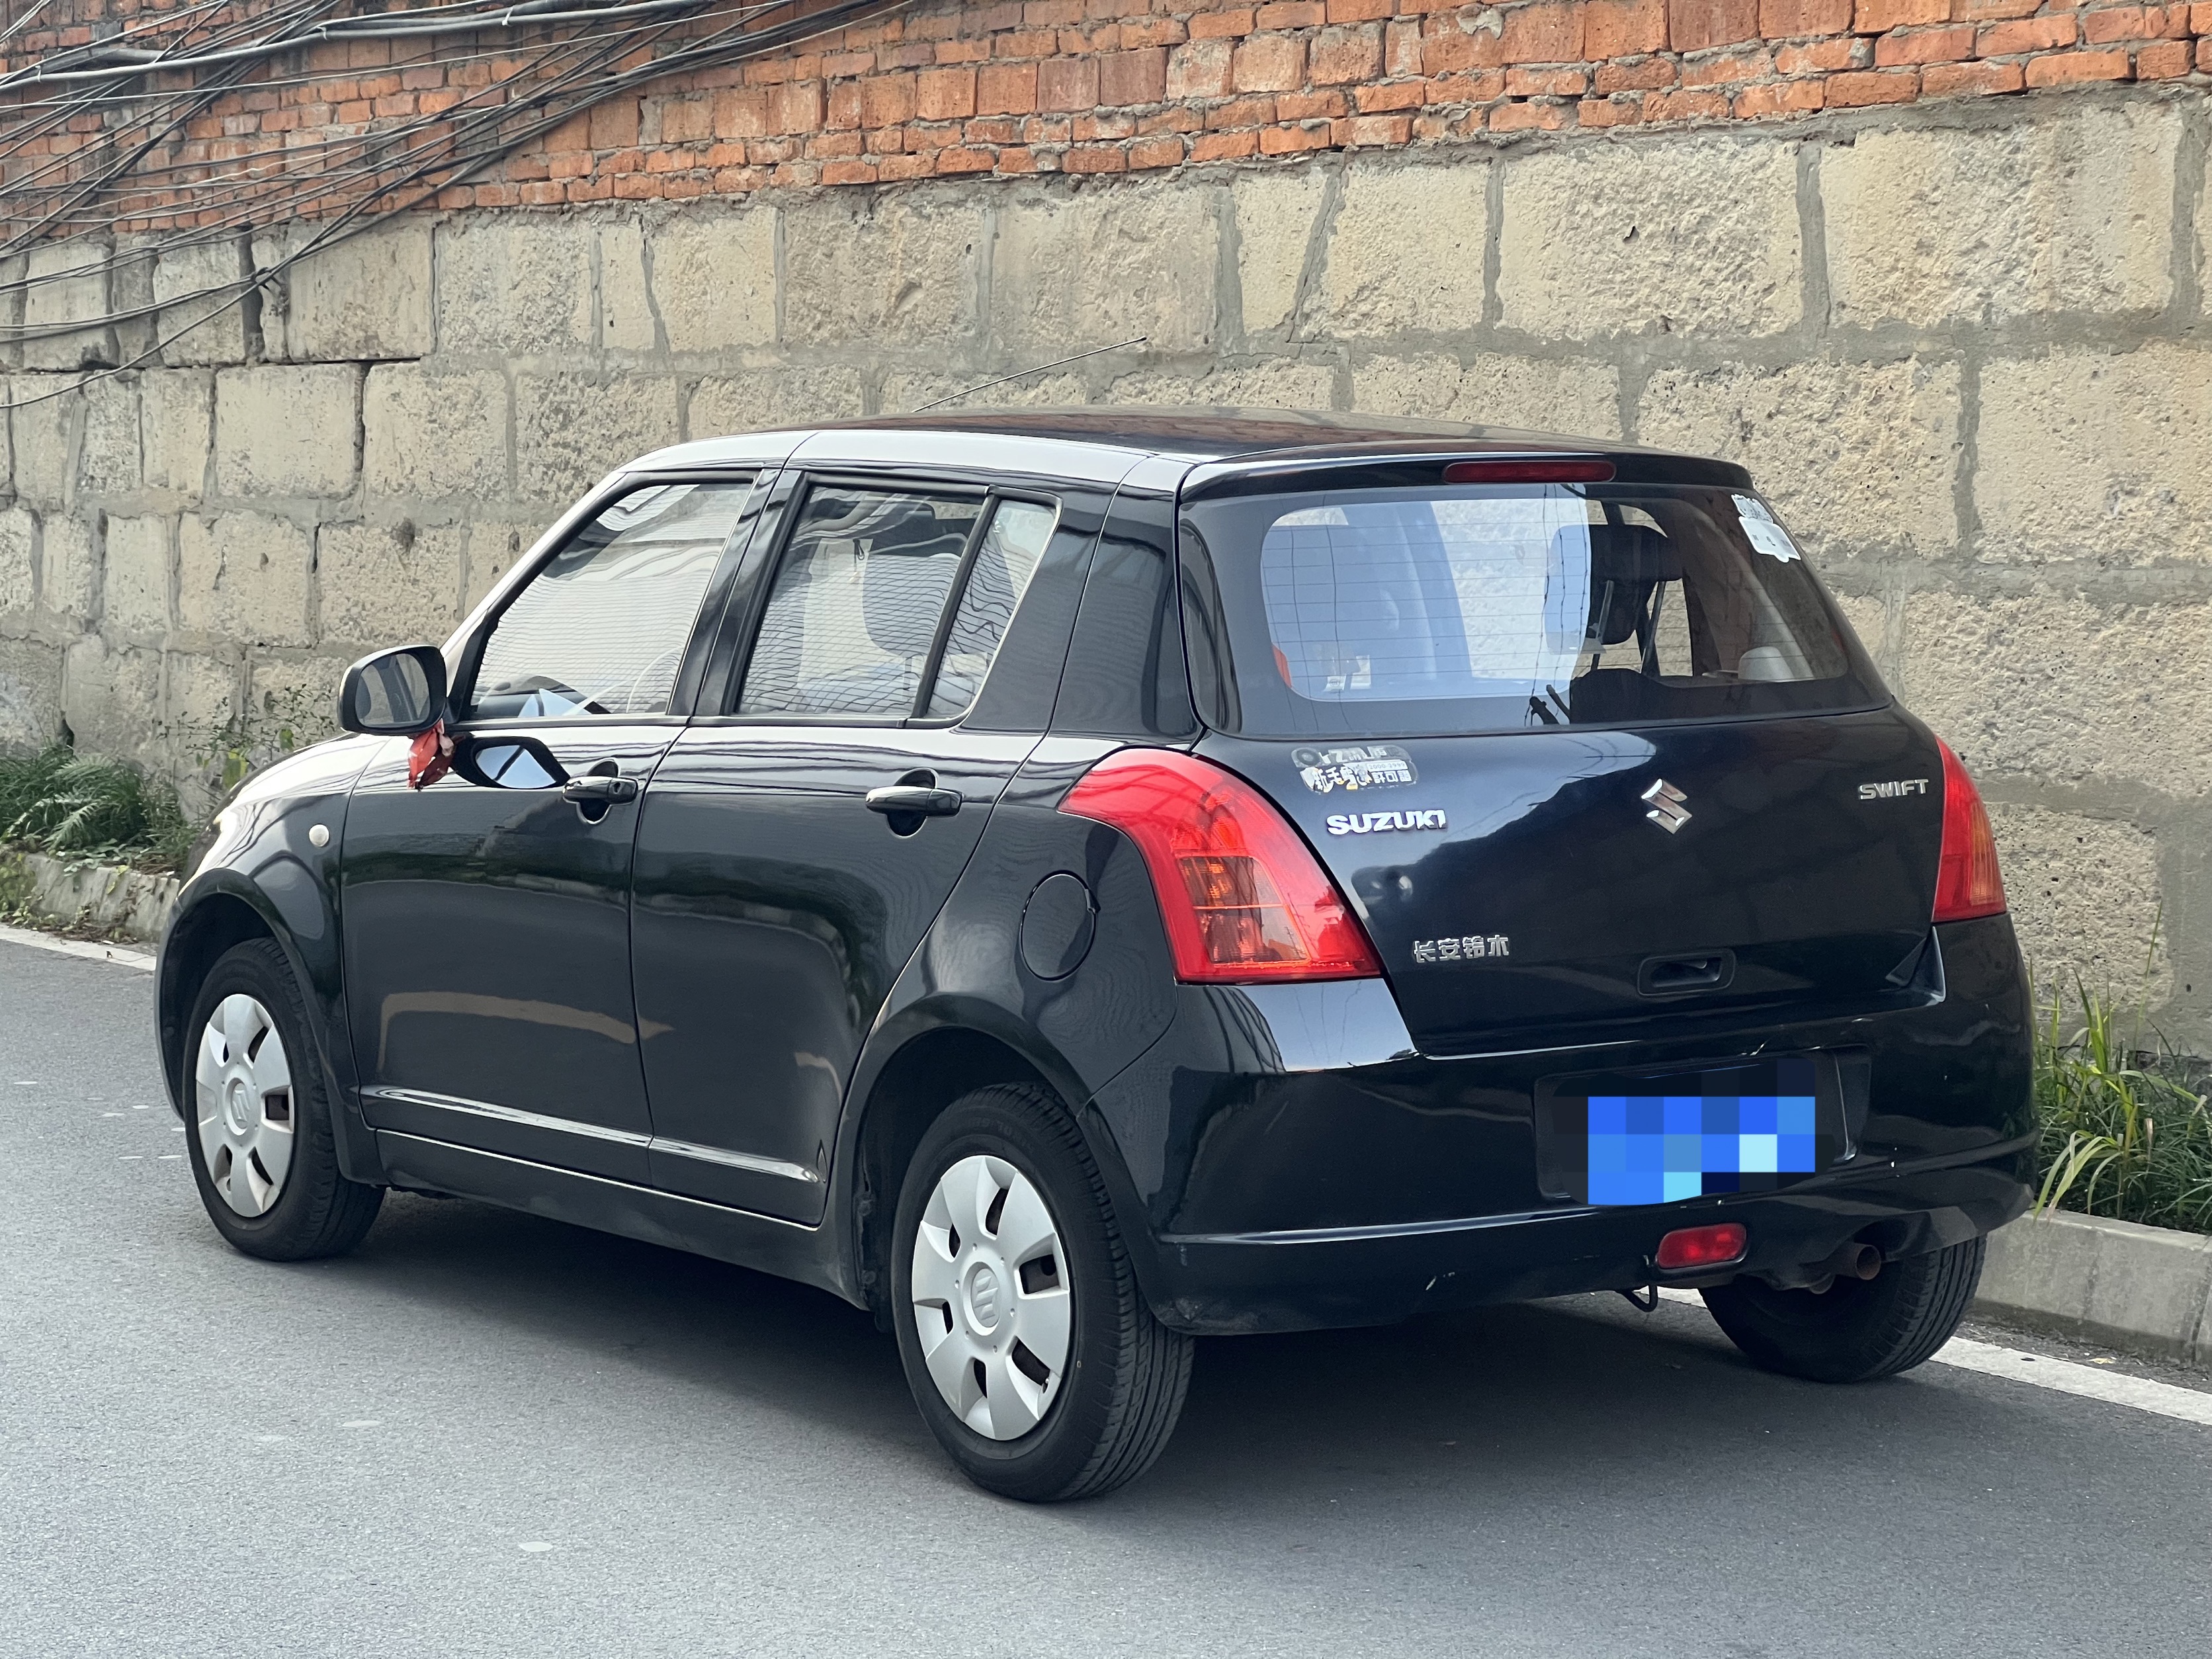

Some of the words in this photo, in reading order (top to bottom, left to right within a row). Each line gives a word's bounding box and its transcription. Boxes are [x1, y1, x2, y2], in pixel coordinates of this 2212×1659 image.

[1858, 779, 1929, 800] SWIFT
[1326, 809, 1447, 835] SUZUKI
[1414, 934, 1510, 963] 长安铃木
